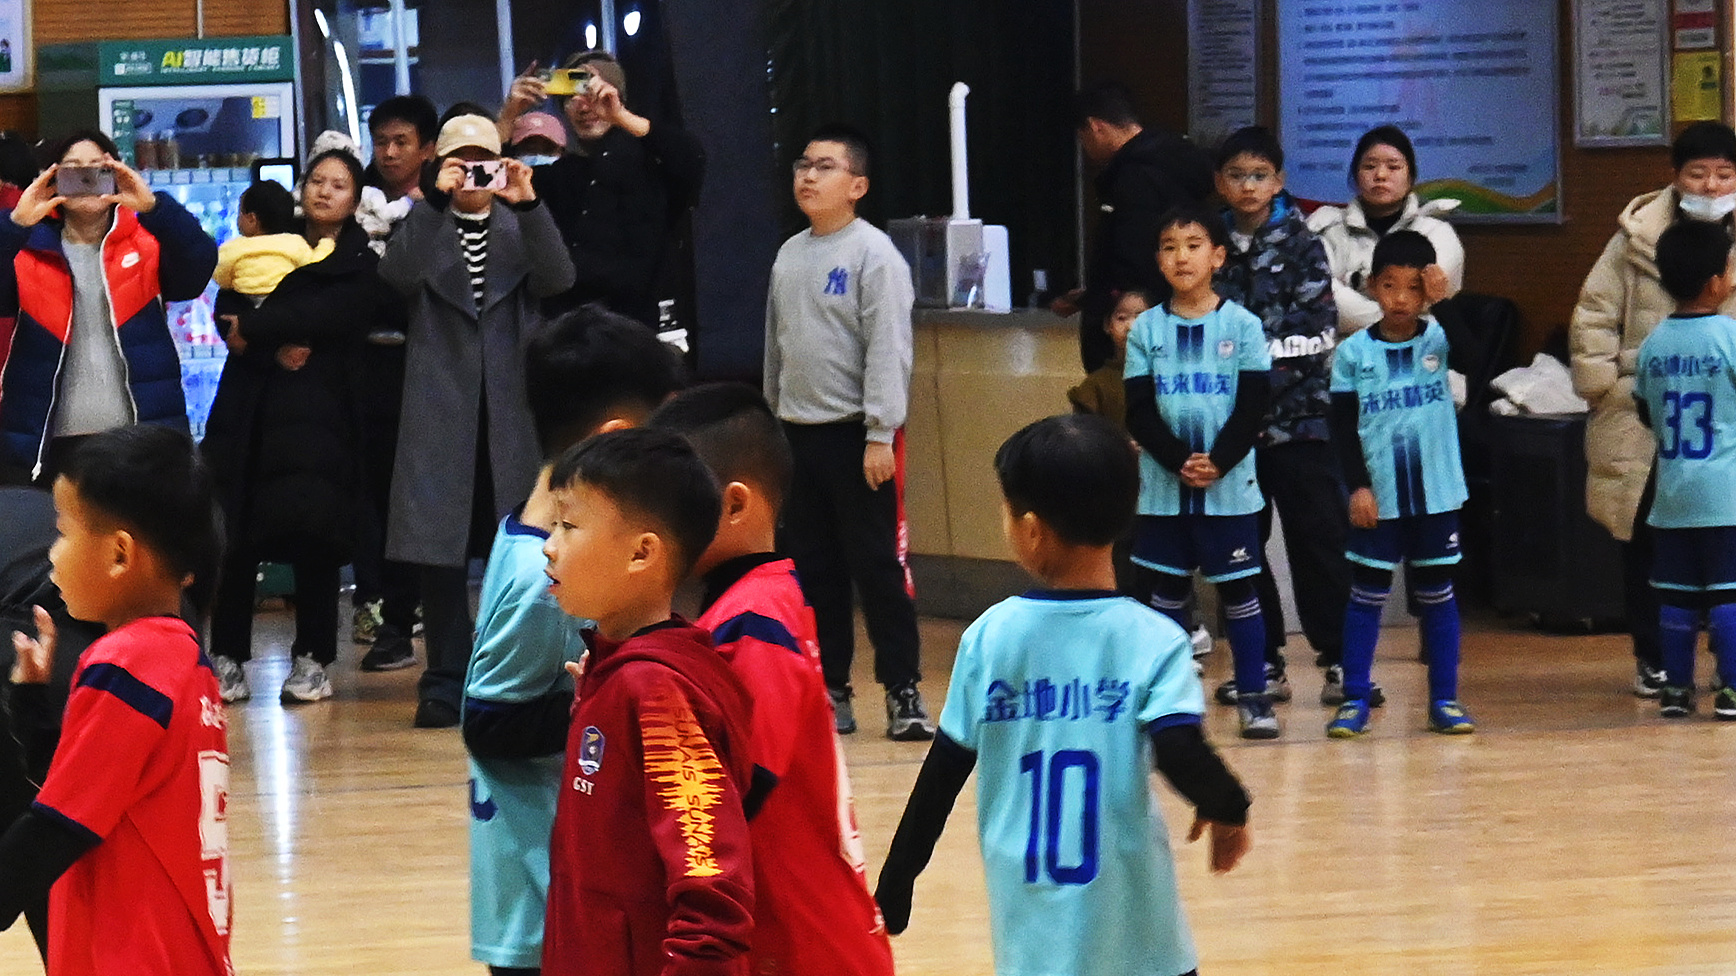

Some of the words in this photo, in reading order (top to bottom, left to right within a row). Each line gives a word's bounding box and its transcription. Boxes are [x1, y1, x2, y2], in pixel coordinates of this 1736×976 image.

[1658, 391, 1714, 460] 33
[983, 677, 1131, 723] 金地小学
[1020, 749, 1100, 885] 10
